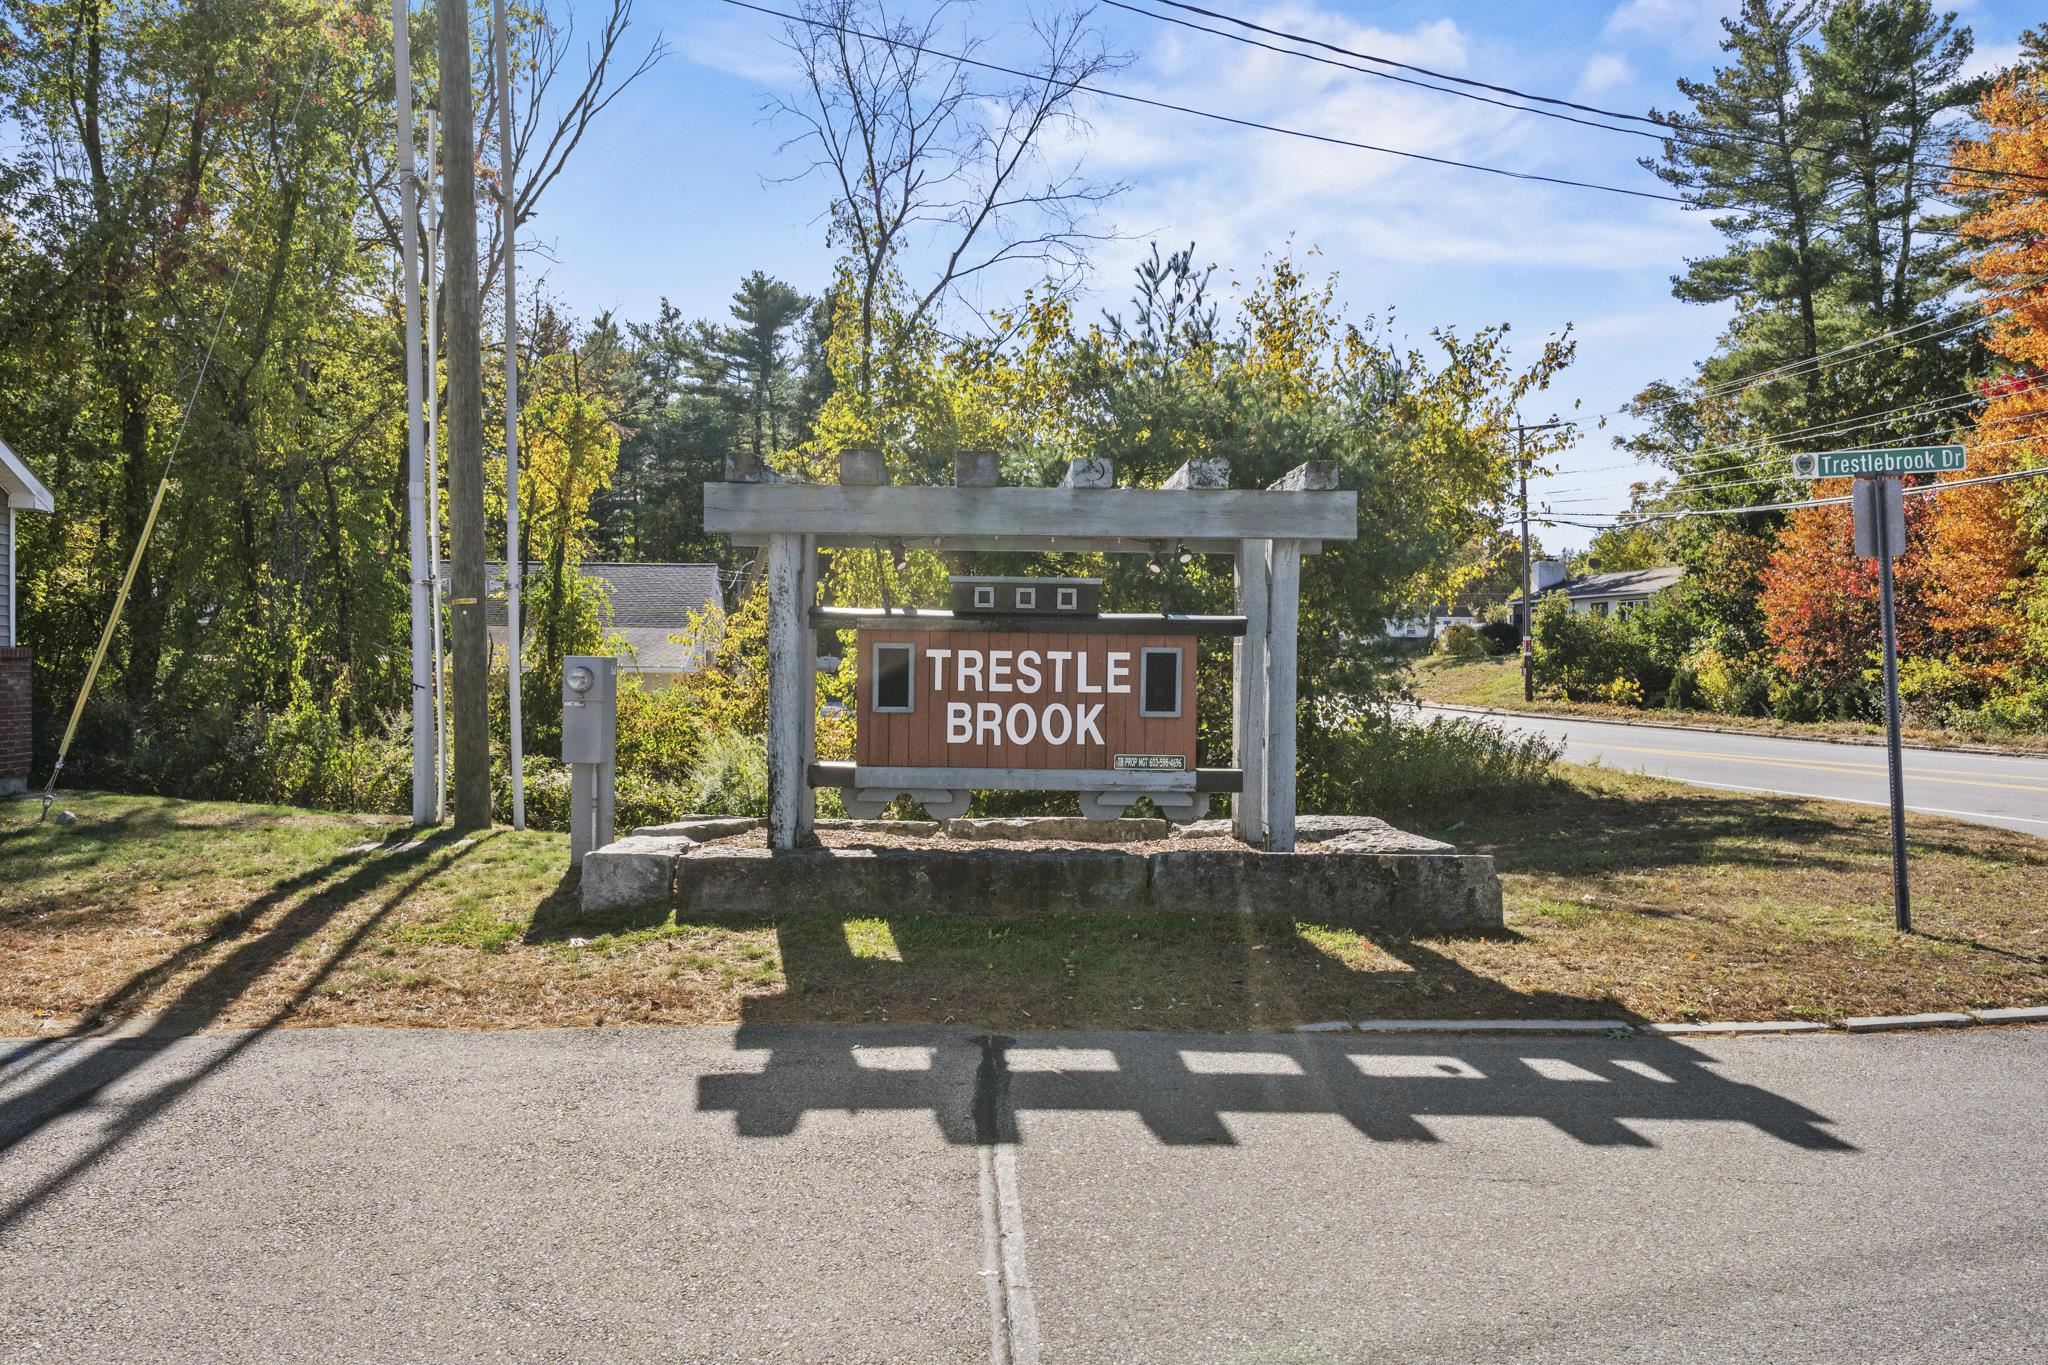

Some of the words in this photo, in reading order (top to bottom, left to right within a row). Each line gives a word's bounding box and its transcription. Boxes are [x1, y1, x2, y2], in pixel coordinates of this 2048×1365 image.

[1821, 452, 1936, 474] Trestlebrook
[1942, 449, 1962, 467] Dr
[926, 649, 1131, 694] TRESTLE
[946, 702, 1105, 746] BROOK
[1124, 757, 1137, 767] PROP
[1138, 757, 1149, 767] MGT
